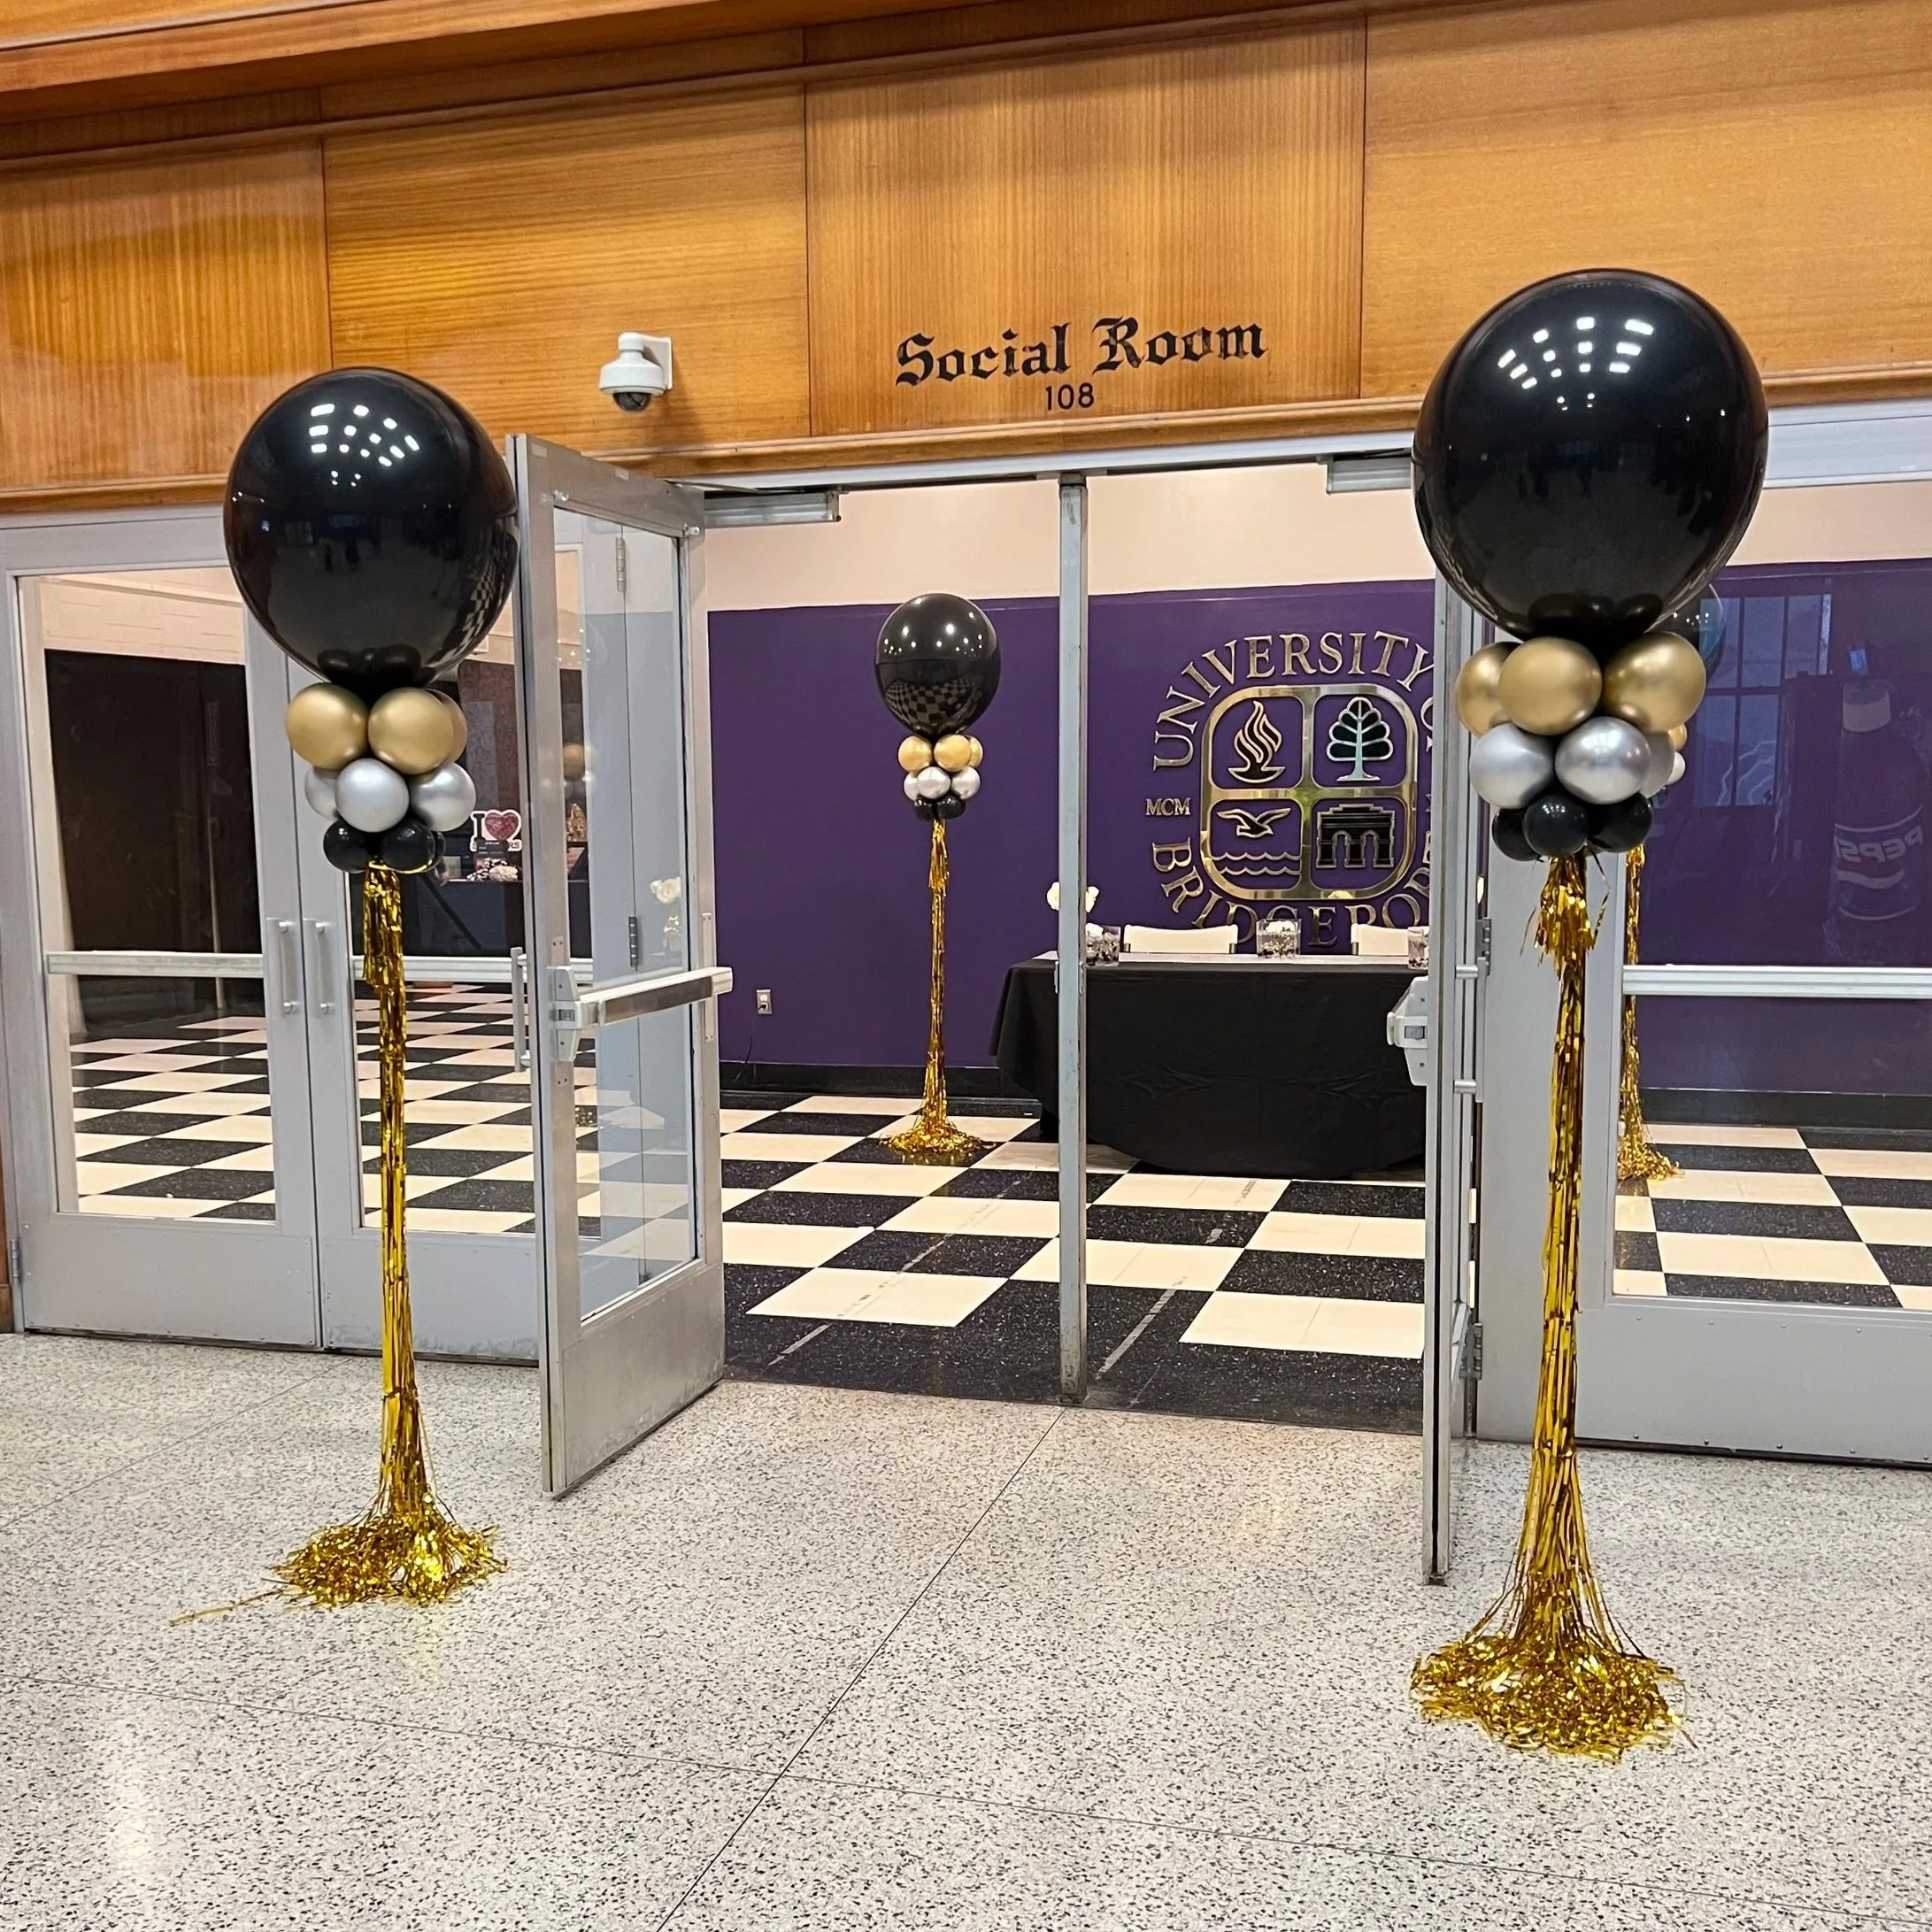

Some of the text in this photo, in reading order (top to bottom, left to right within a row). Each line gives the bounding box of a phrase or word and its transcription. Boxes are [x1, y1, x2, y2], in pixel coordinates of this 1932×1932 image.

[895, 315, 1269, 388] Social Room
[1045, 382, 1095, 411] 108
[1153, 631, 1434, 771] UNIVERSITY
[1145, 797, 1191, 816] MCM
